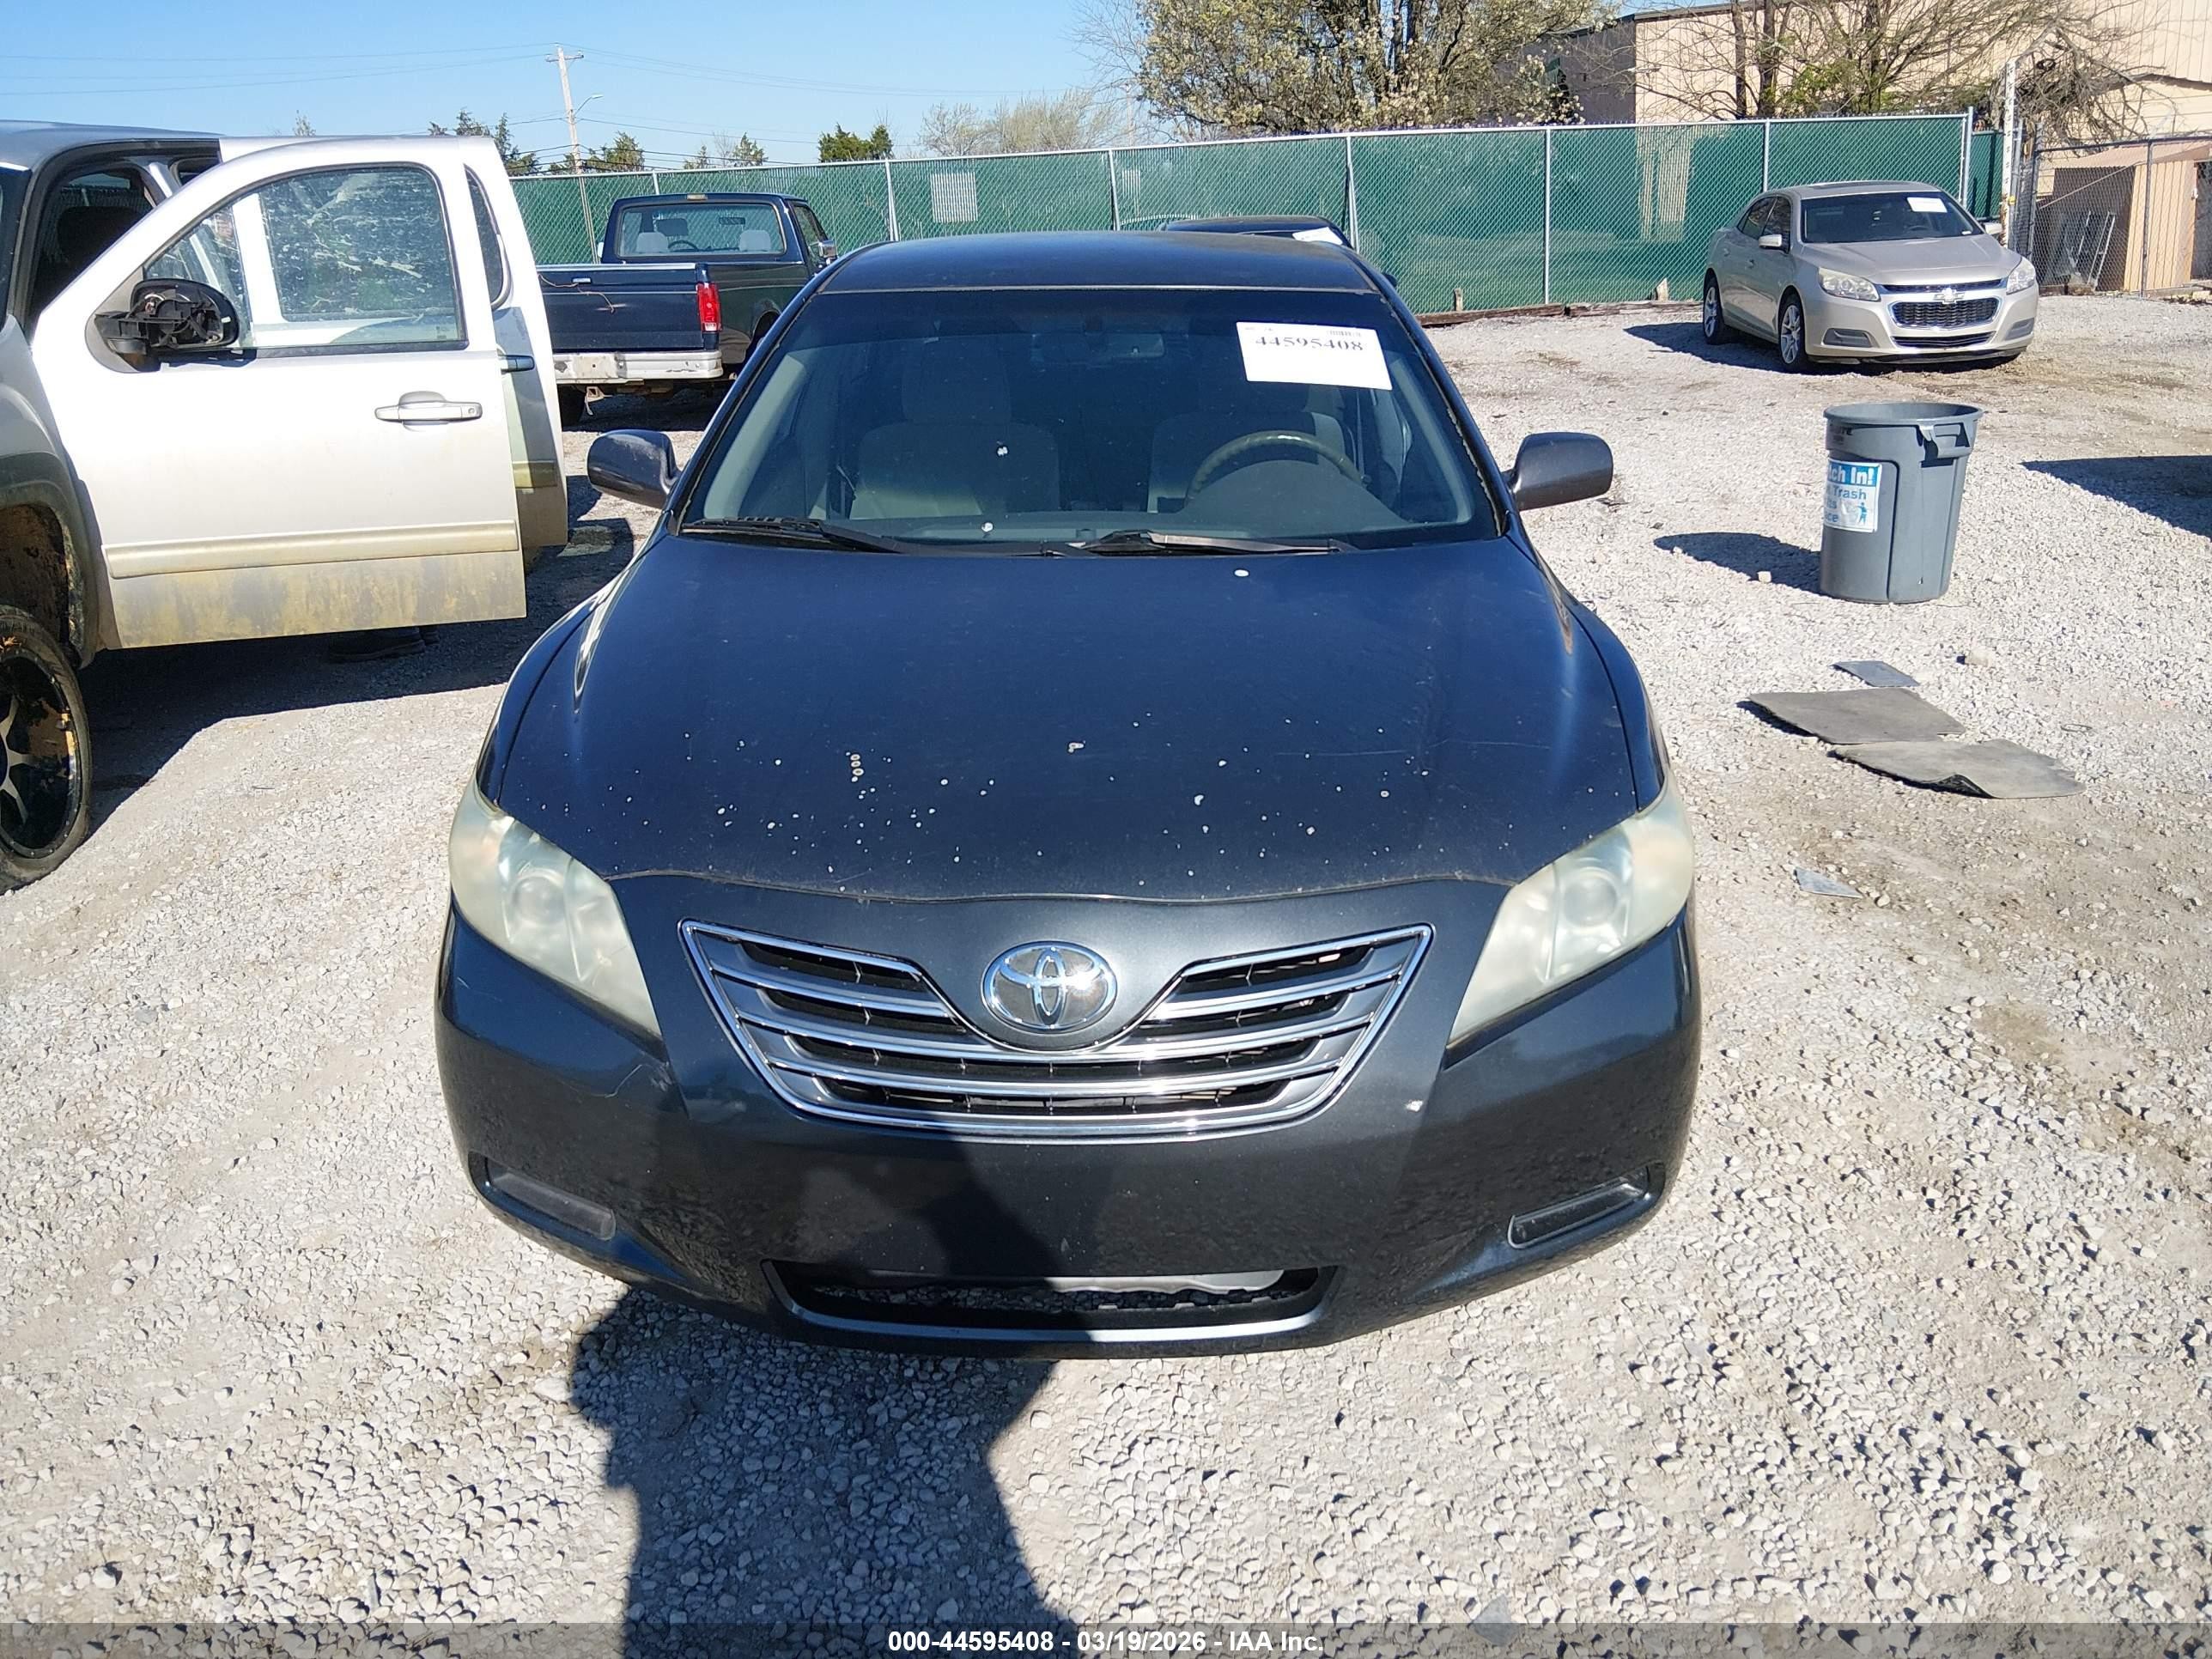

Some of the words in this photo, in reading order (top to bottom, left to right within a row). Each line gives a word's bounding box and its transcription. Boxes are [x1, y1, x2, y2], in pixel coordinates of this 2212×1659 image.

[1255, 336, 1364, 351] 44595408
[1850, 466, 1875, 486] In!
[1833, 485, 1867, 500] Trash
